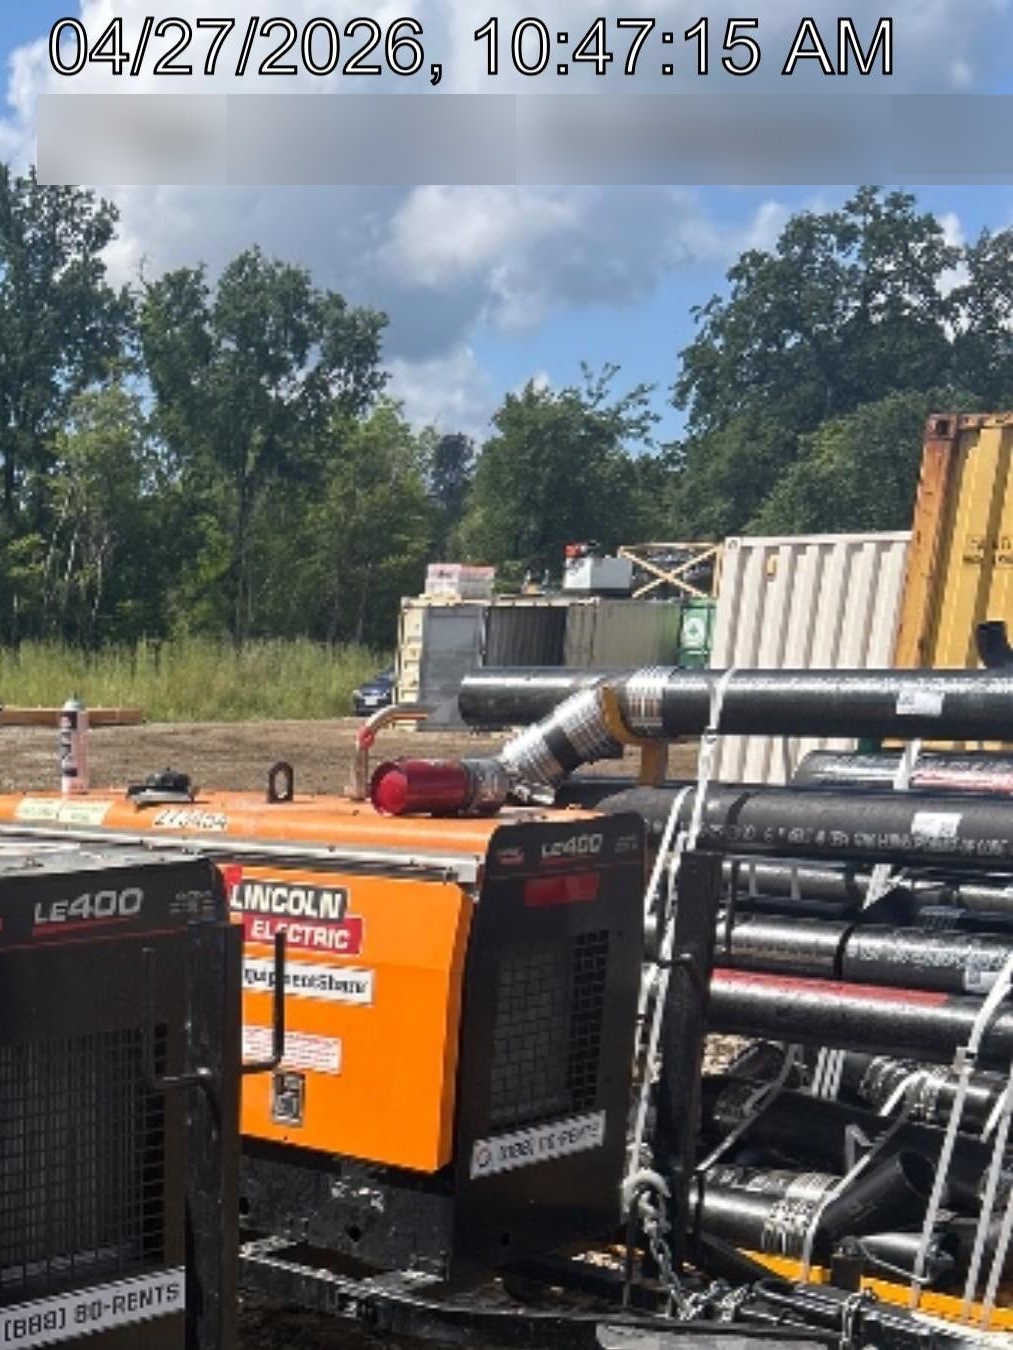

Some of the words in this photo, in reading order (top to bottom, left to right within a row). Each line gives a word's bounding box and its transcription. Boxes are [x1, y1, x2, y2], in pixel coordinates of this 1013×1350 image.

[33, 887, 145, 924] LE400
[230, 884, 343, 920] LINCOLN
[244, 968, 368, 995] quipentShare
[74, 1283, 181, 1325] 80-RENTS
